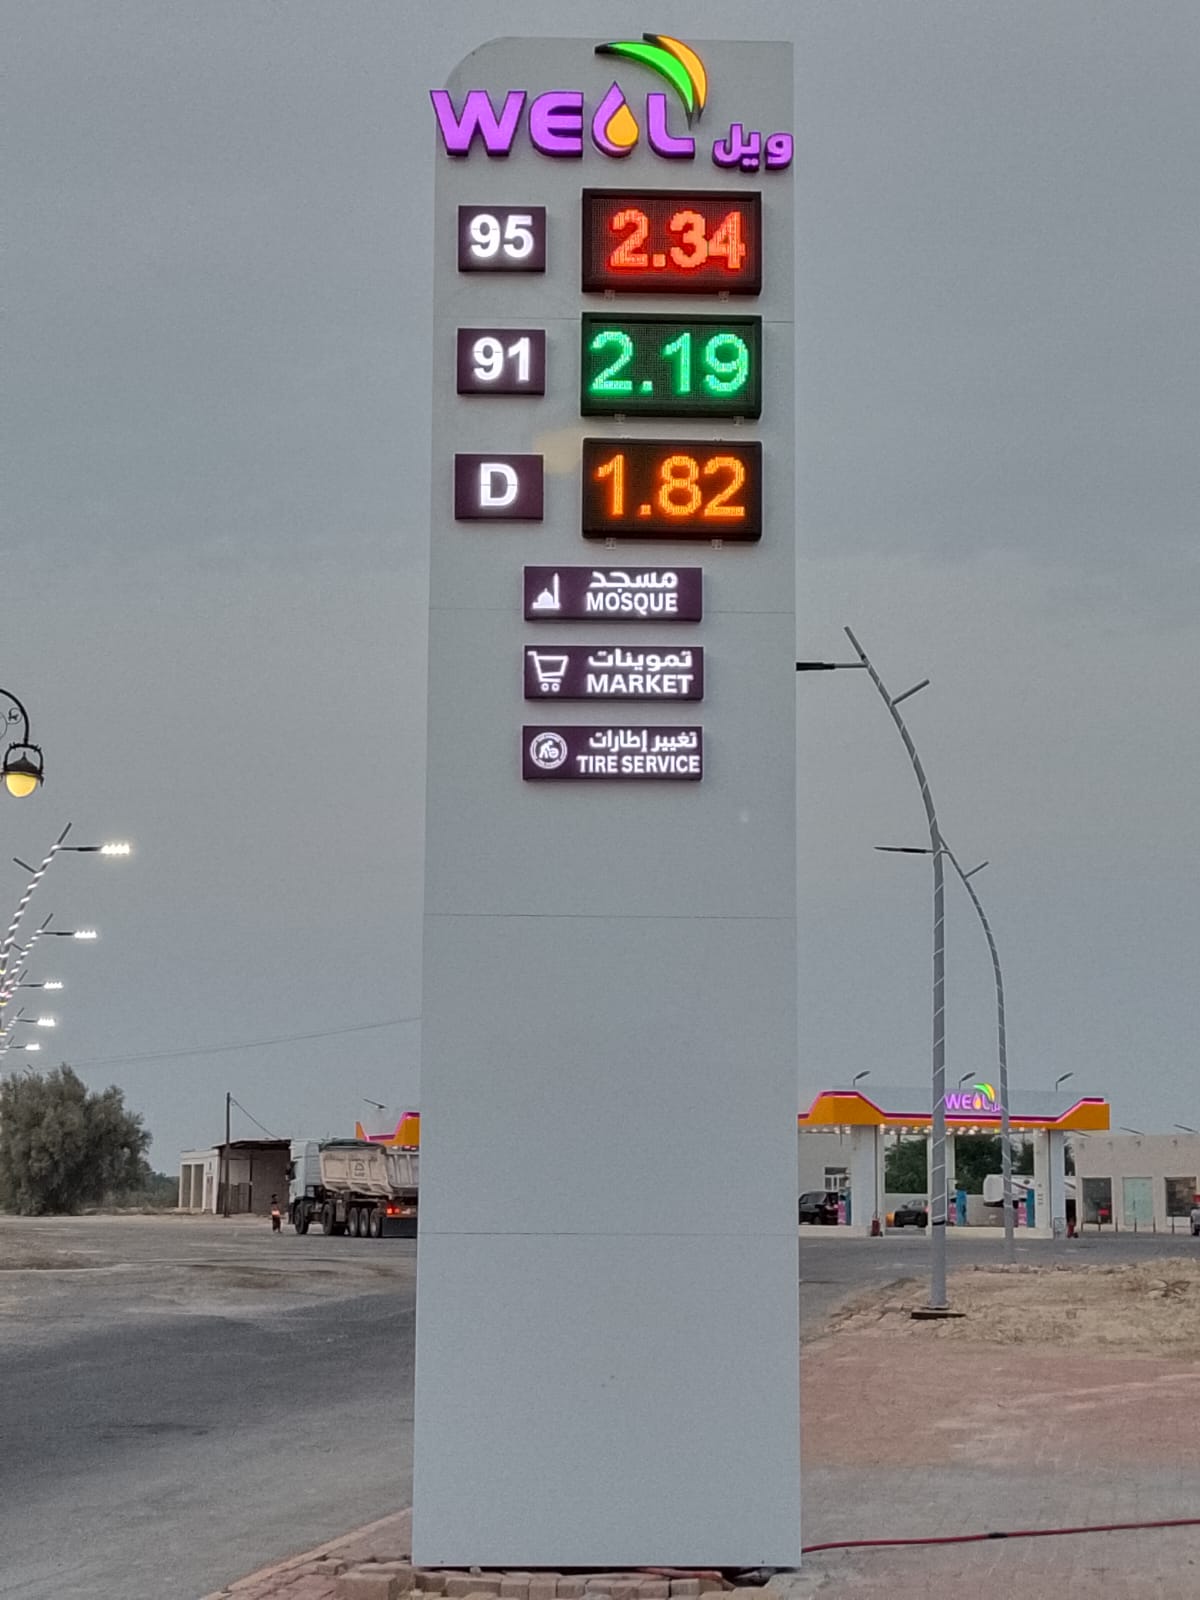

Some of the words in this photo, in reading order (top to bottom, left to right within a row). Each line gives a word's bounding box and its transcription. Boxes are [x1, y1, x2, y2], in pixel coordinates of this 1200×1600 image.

[713, 124, 794, 172] ويل
[470, 213, 534, 258] 95
[609, 209, 746, 269] 2.34
[472, 336, 530, 381] 91
[591, 331, 749, 392] 2.19
[479, 462, 518, 507] D
[596, 454, 745, 516] 1.82
[585, 592, 678, 615] MOSQUE
[589, 571, 678, 594] مسجد
[587, 648, 693, 671] تموينات
[586, 674, 694, 694] MARKET
[651, 731, 698, 751] تغيير
[576, 755, 618, 773] TIRE
[621, 755, 701, 774] SERVICE
